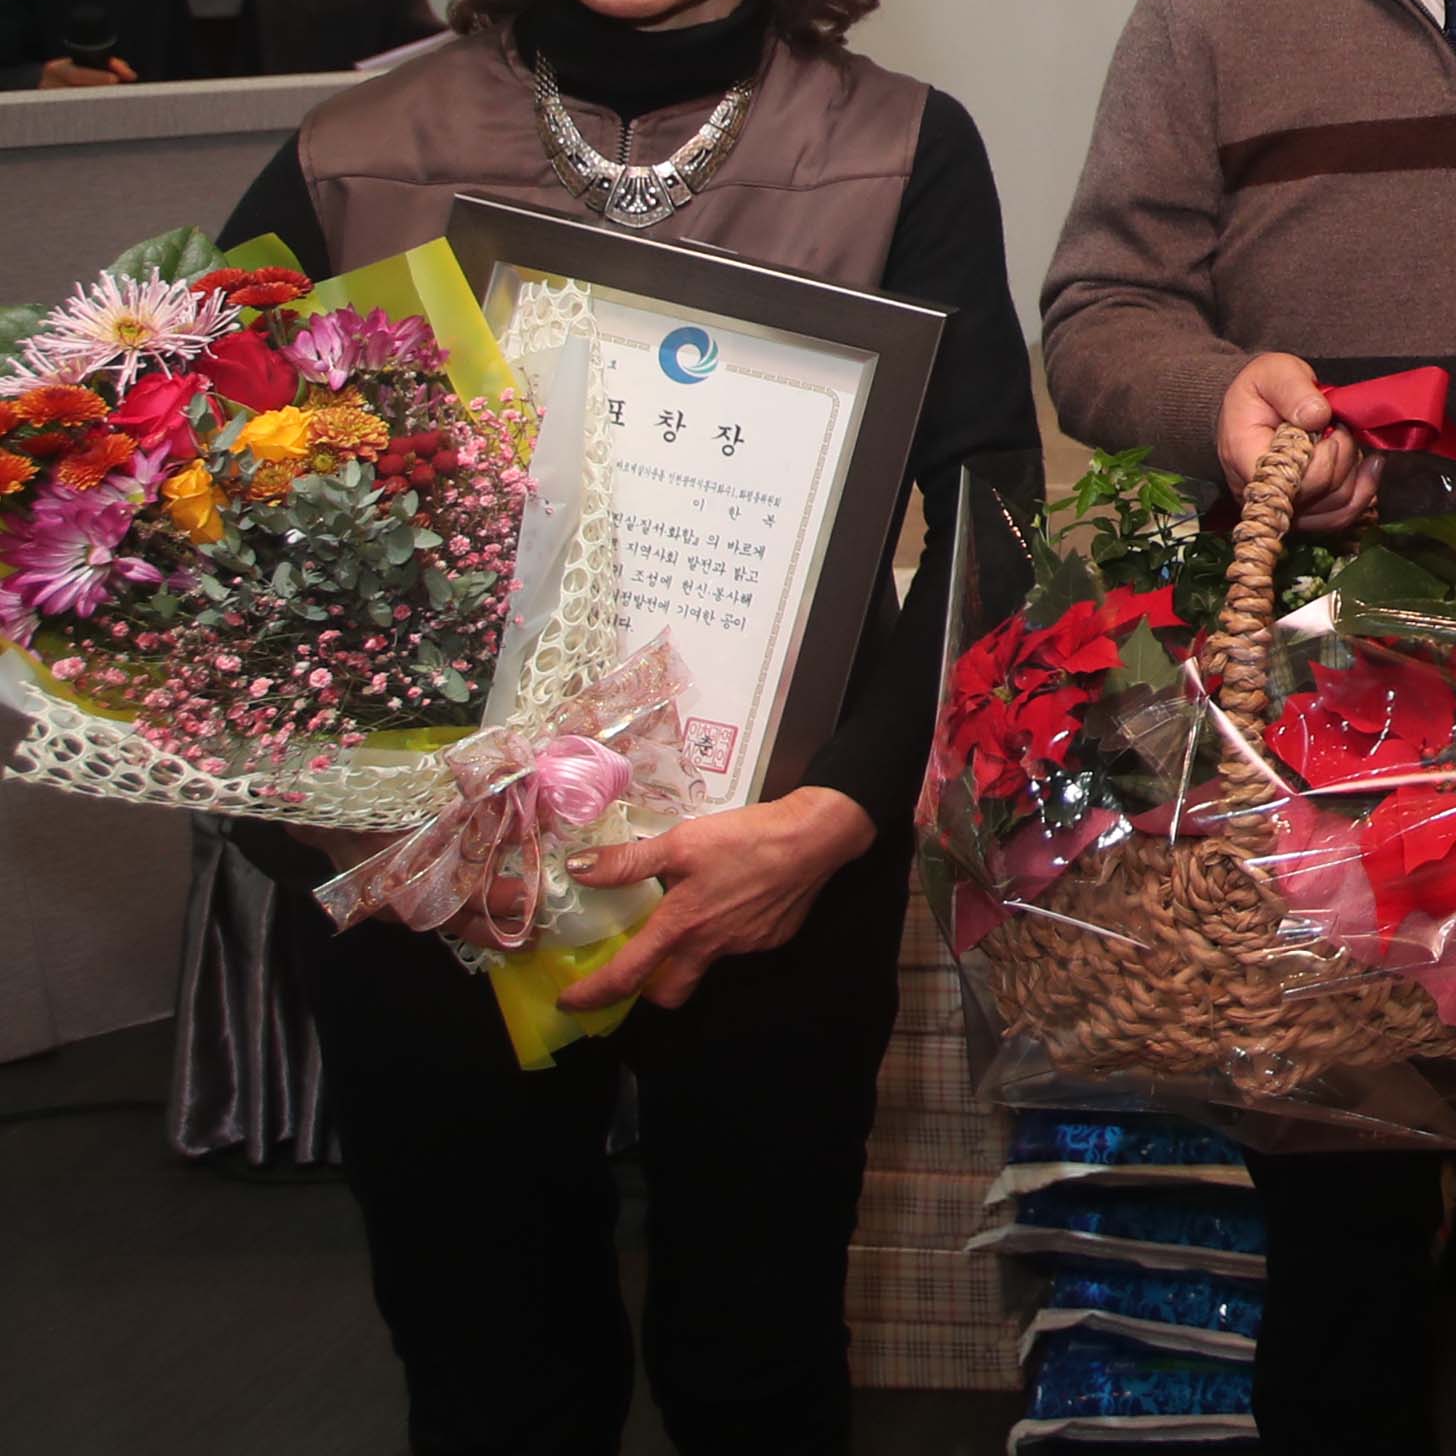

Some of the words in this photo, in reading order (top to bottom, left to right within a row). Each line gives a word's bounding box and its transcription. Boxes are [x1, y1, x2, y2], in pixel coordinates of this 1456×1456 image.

[655, 410, 687, 443] 창
[712, 424, 745, 457] 장
[705, 534, 721, 550] 의
[727, 540, 767, 560] 바르게
[626, 541, 680, 565] 지역사회
[687, 555, 728, 578] 발전과
[733, 566, 760, 584] 밝고
[631, 569, 673, 590] 조성에
[675, 604, 716, 627] 기여한
[720, 612, 747, 632] 공이
